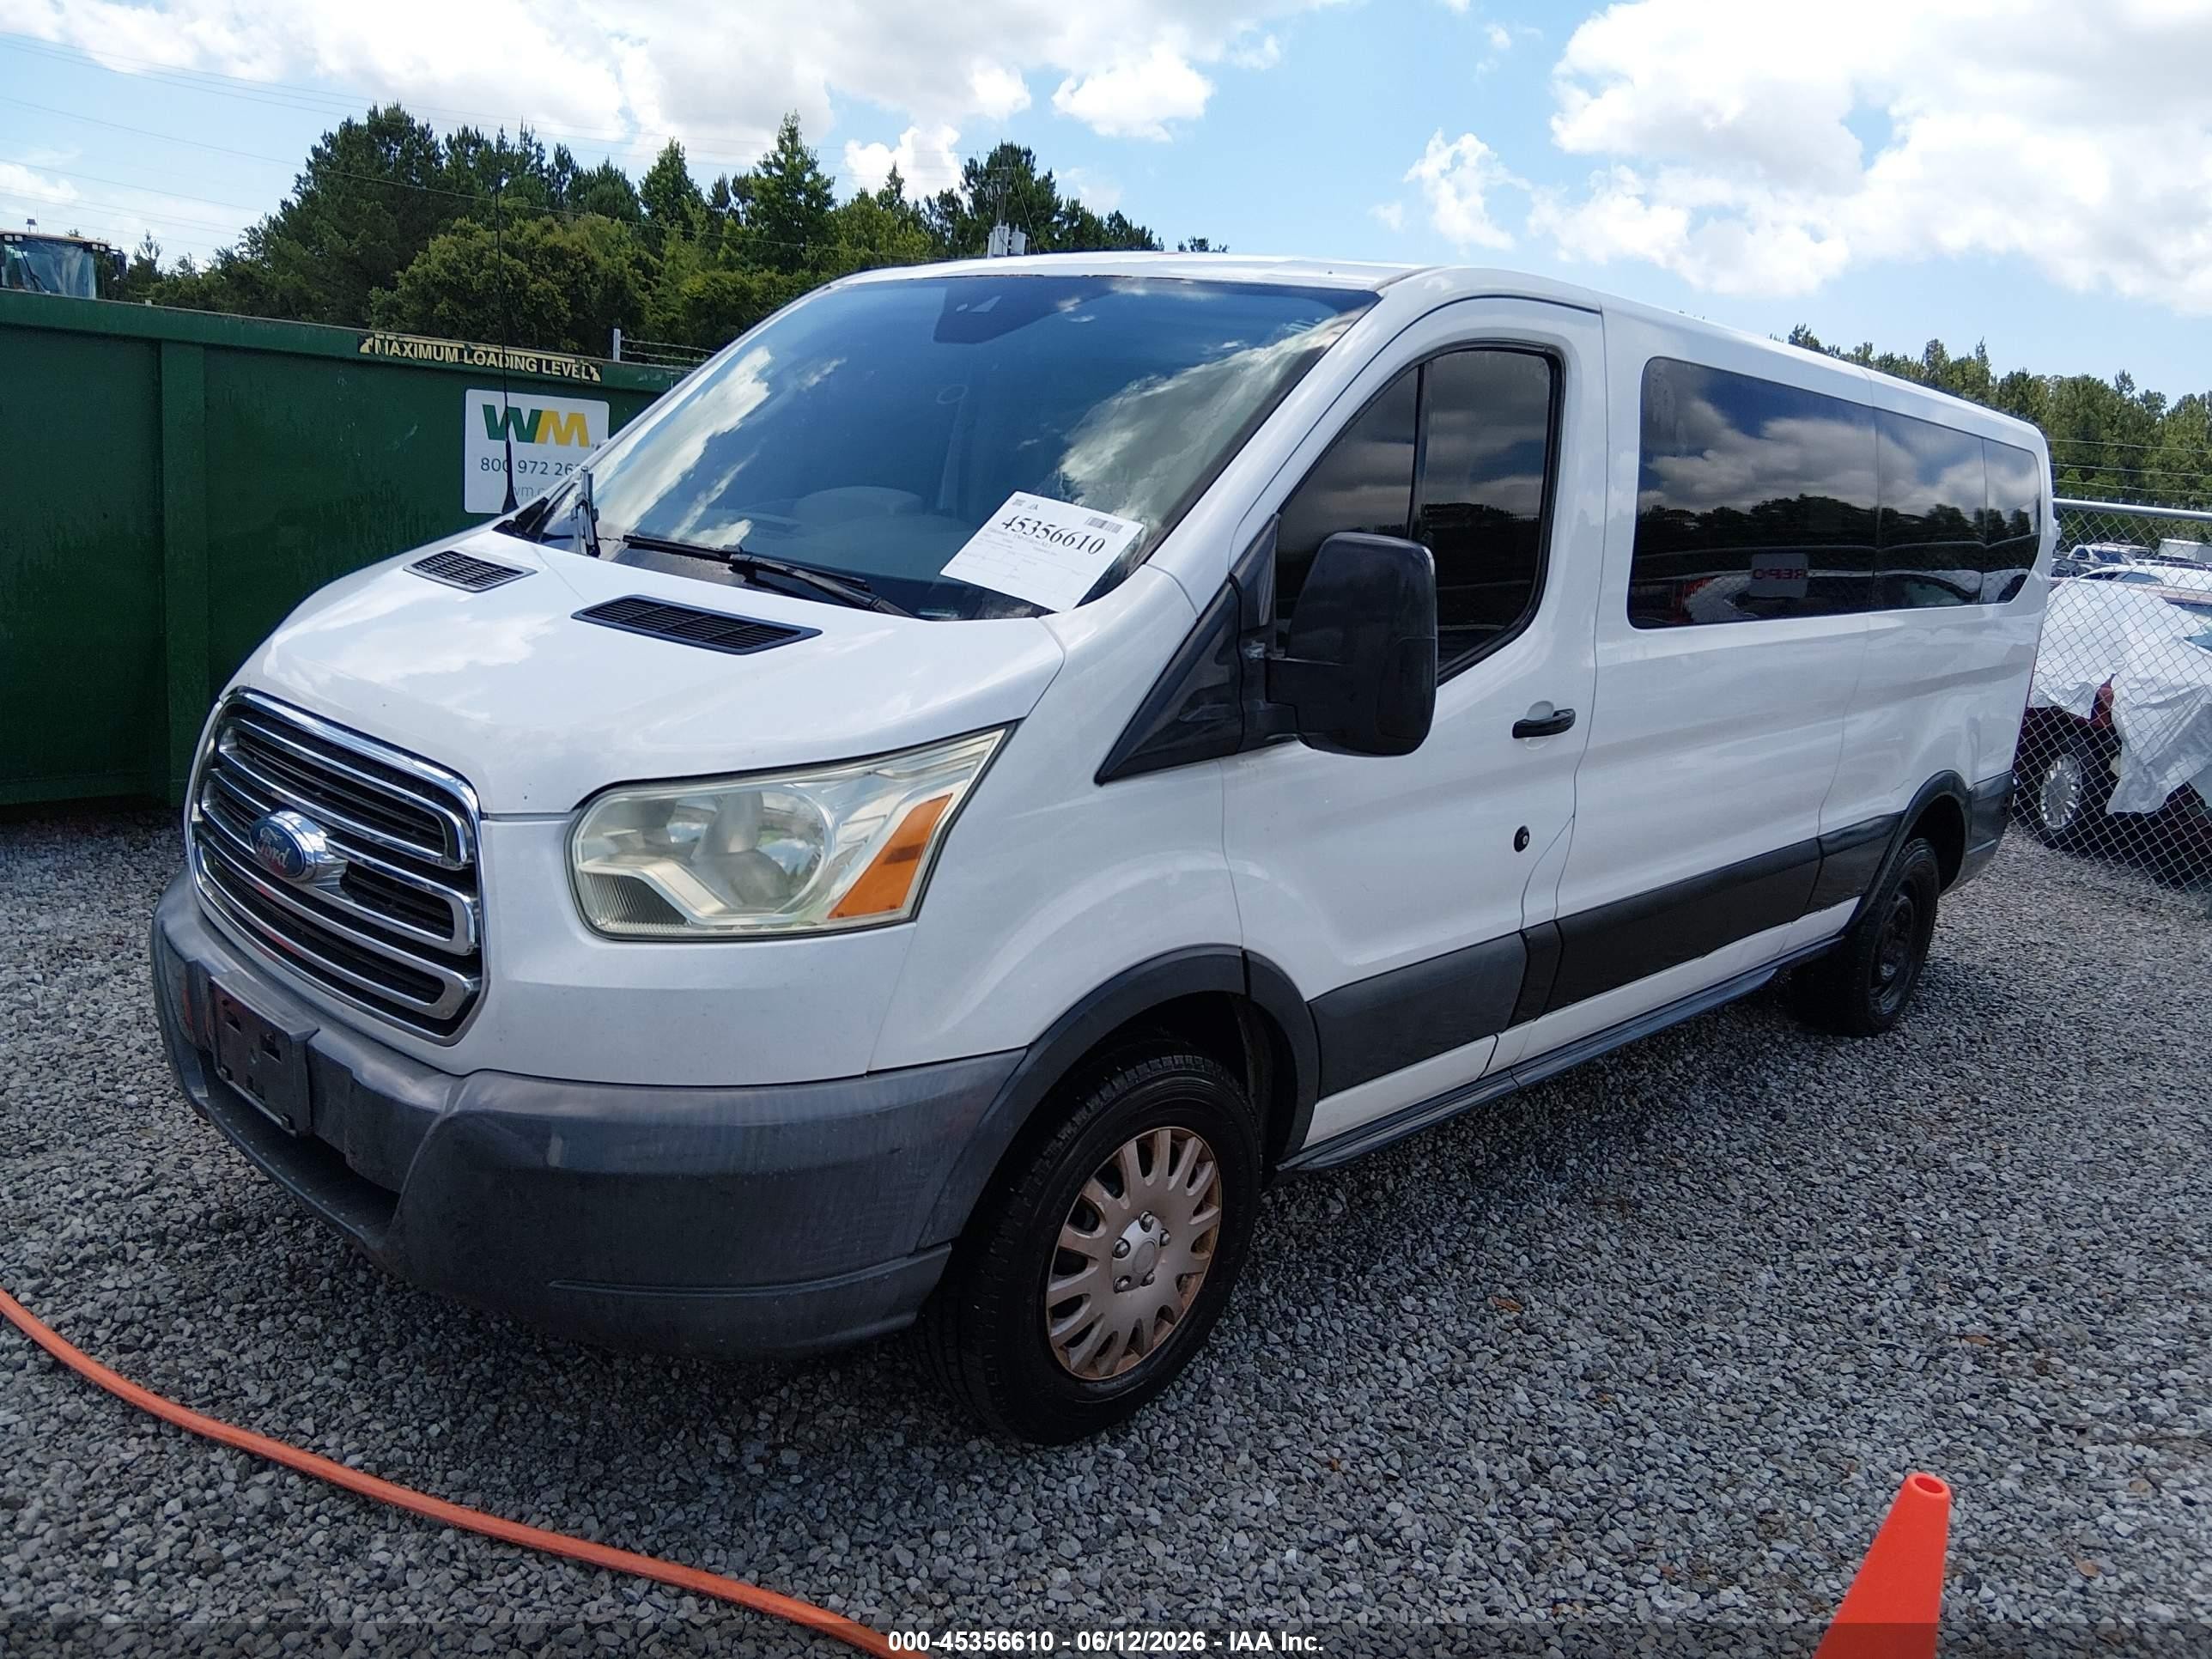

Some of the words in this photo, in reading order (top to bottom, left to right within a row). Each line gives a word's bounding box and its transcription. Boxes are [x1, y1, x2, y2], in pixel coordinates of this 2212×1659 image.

[374, 338, 459, 362] MAXIMUM
[464, 349, 538, 373] LOADING
[482, 404, 591, 447] WM
[518, 459, 548, 476] 972
[555, 462, 580, 476] 26
[1001, 515, 1106, 555] 45356610
